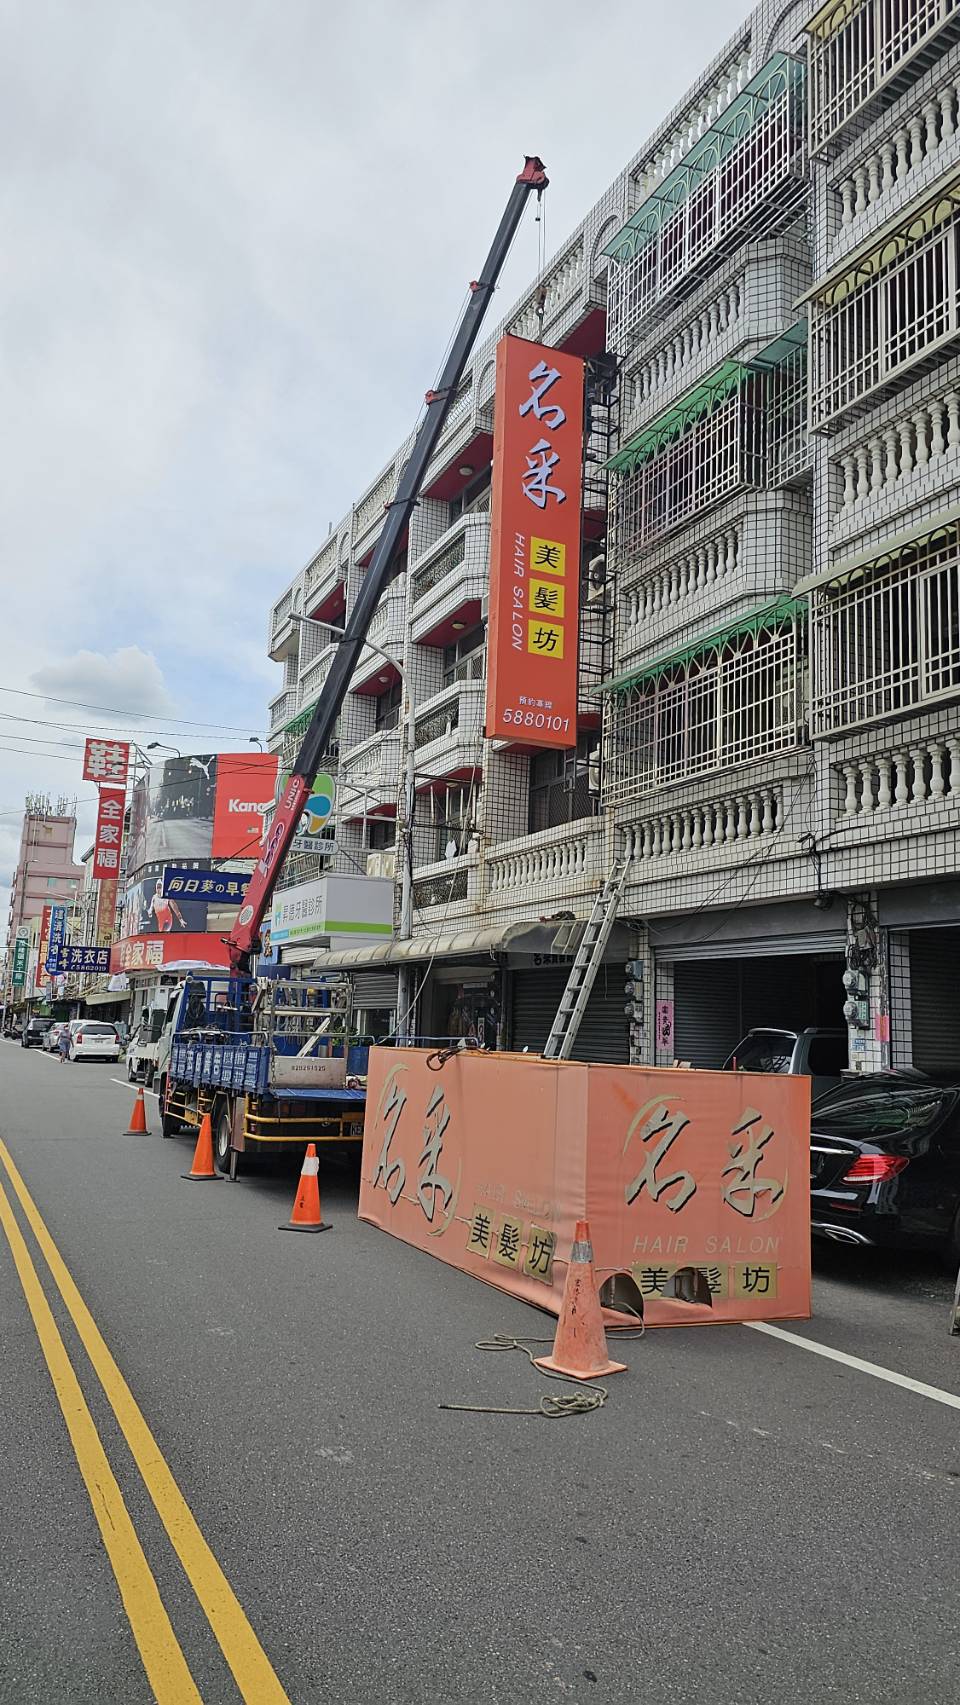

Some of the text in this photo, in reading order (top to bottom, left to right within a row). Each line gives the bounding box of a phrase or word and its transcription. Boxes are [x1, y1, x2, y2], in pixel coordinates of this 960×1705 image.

[516, 359, 567, 510] 名采
[511, 531, 525, 651] HAIR SALON
[532, 542, 562, 655] 美髮坊
[502, 708, 570, 733] 5880101
[87, 741, 126, 779] 鞋
[284, 778, 301, 809] UNIC
[97, 799, 123, 869] 全家福
[71, 948, 109, 964] 洗衣店
[373, 1083, 453, 1222] 名采
[627, 1105, 785, 1217] 名采
[471, 1213, 553, 1274] 美髮坊
[633, 1235, 780, 1254] HAIR SALON
